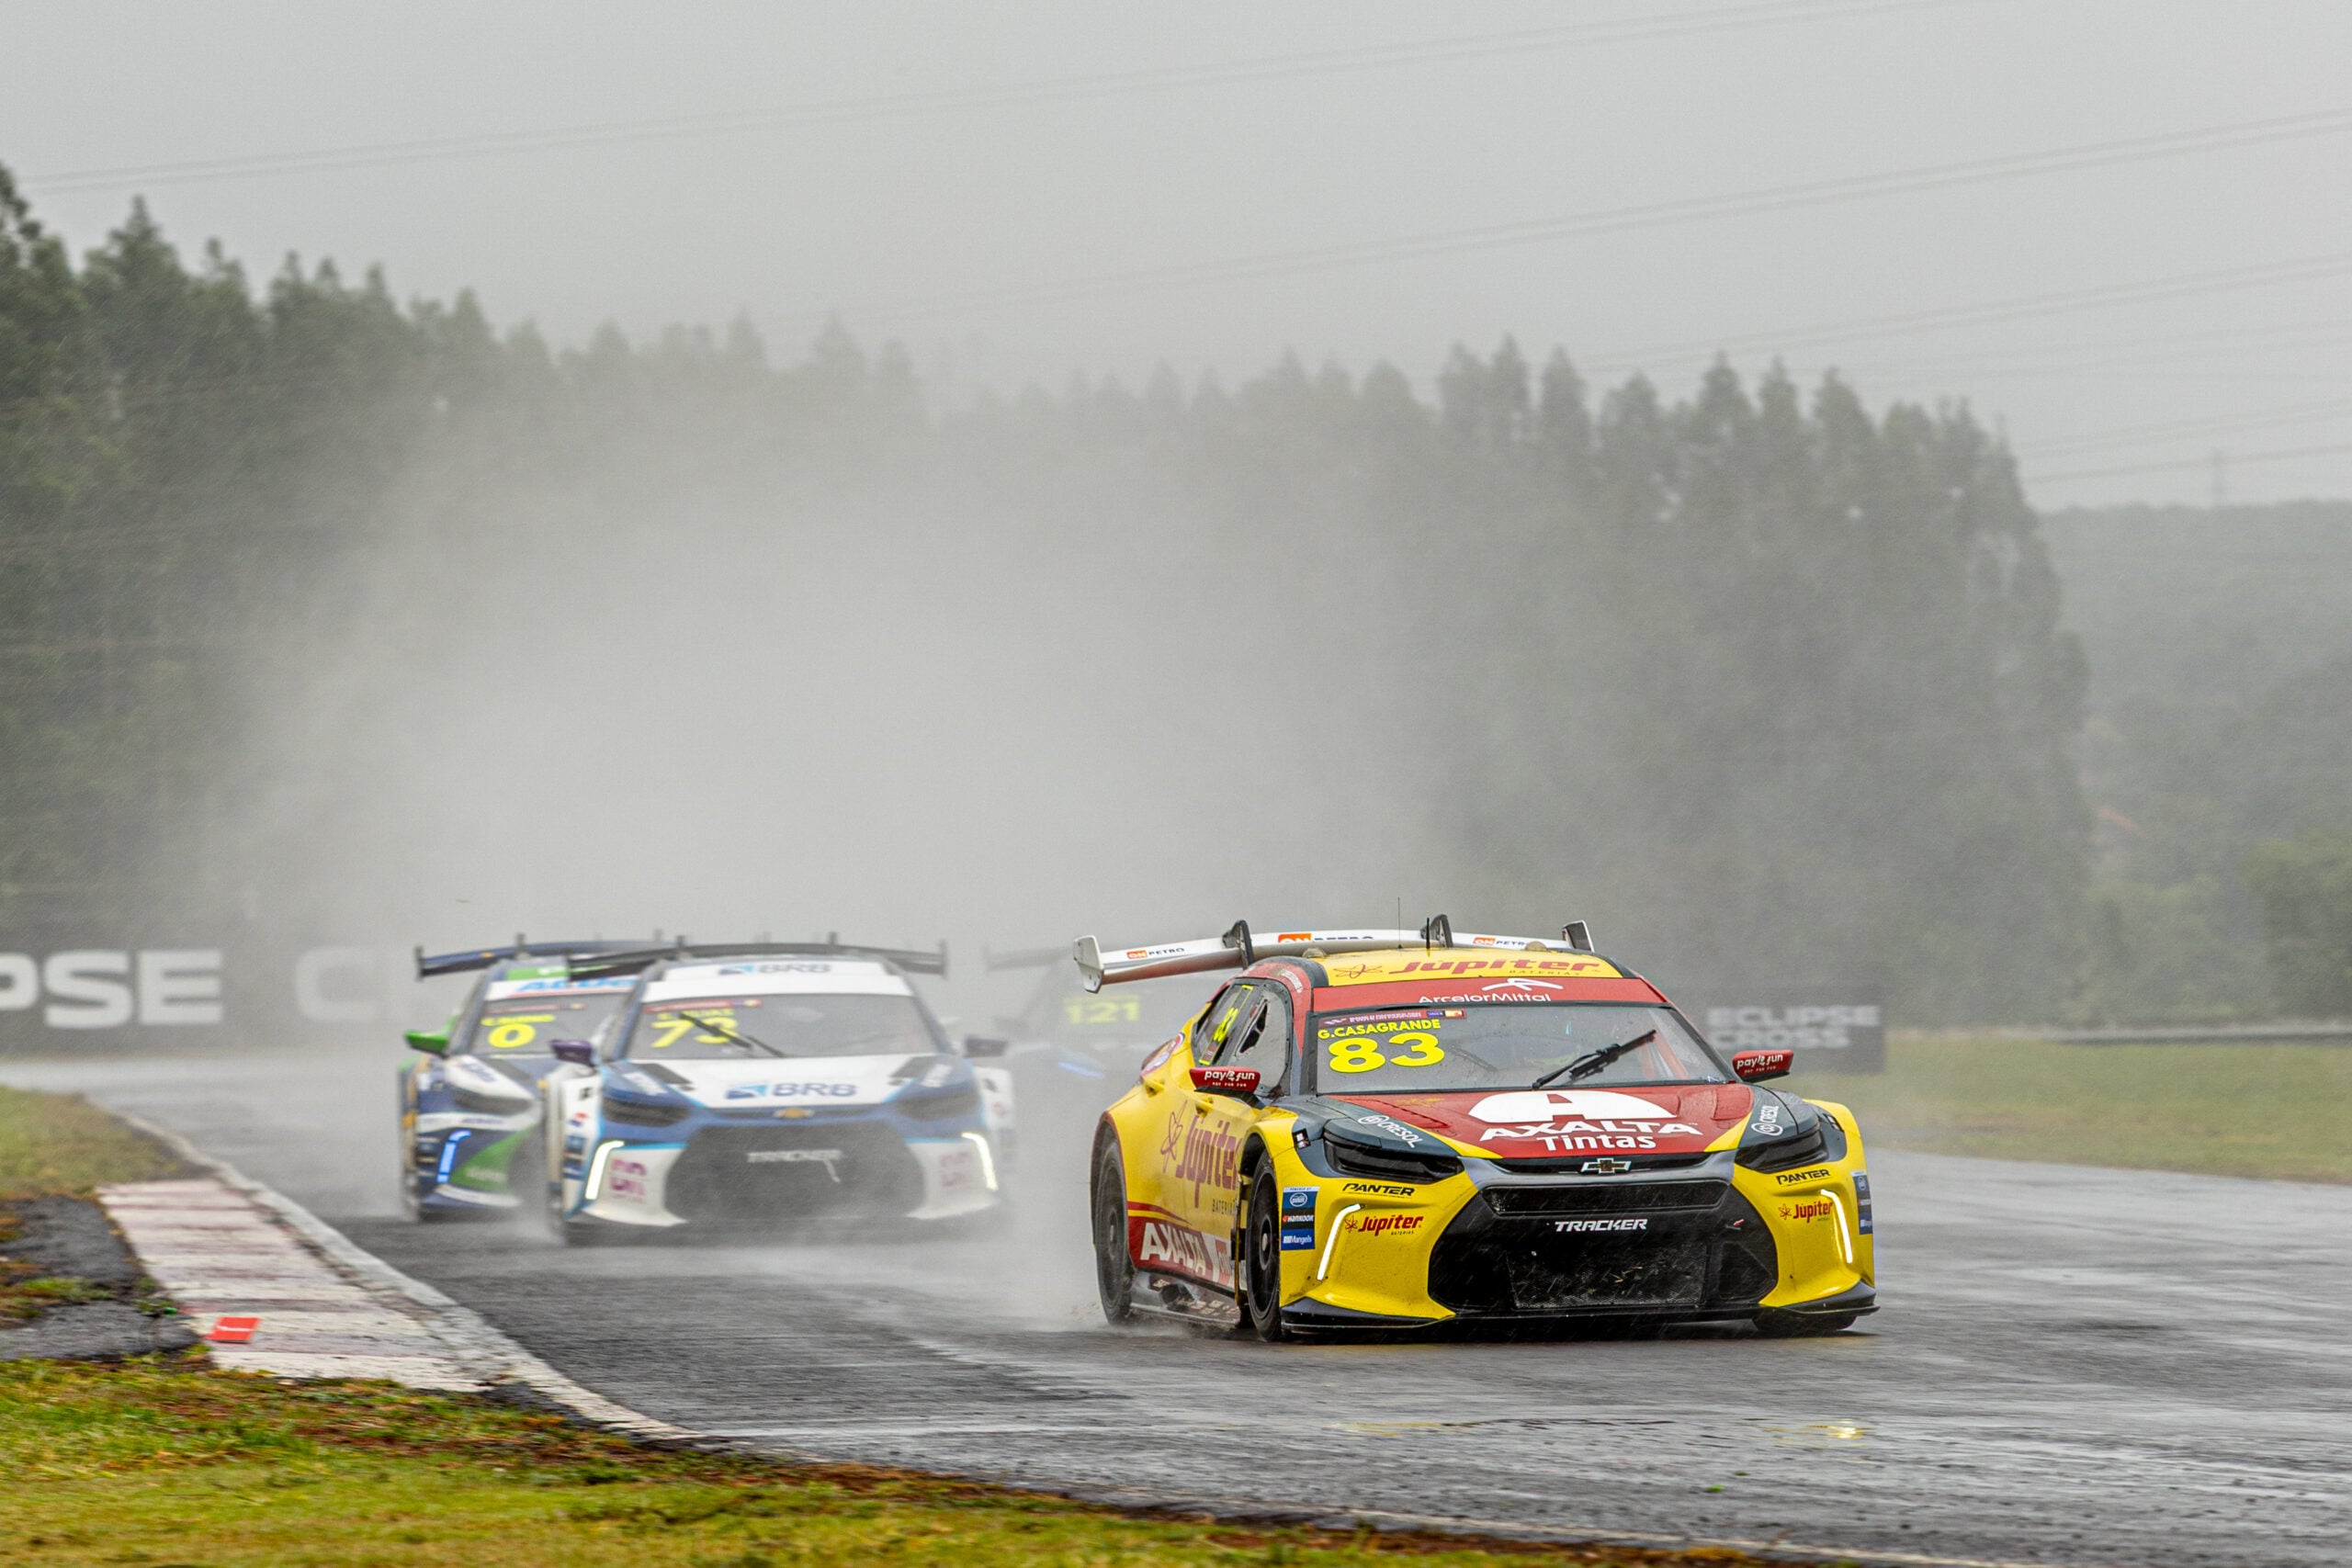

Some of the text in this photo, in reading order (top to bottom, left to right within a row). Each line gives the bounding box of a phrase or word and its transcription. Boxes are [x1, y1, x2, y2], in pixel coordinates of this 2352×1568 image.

[1148, 947, 1185, 955] PETRO
[759, 964, 831, 974] BRB
[1419, 993, 1551, 1003] ArcelorMittal
[1066, 1001, 1139, 1024] 121
[650, 1017, 739, 1047] 73
[1317, 1019, 1442, 1040] G.CASAGRANDE
[1329, 1032, 1445, 1073] 83
[772, 1082, 857, 1098] BRB
[1479, 1121, 1703, 1142] AXALTA
[1537, 1134, 1657, 1152] Tintas
[1776, 1168, 1831, 1186] PANTER
[1342, 1183, 1415, 1197] PANTER
[1555, 1218, 1648, 1233] TRACKER
